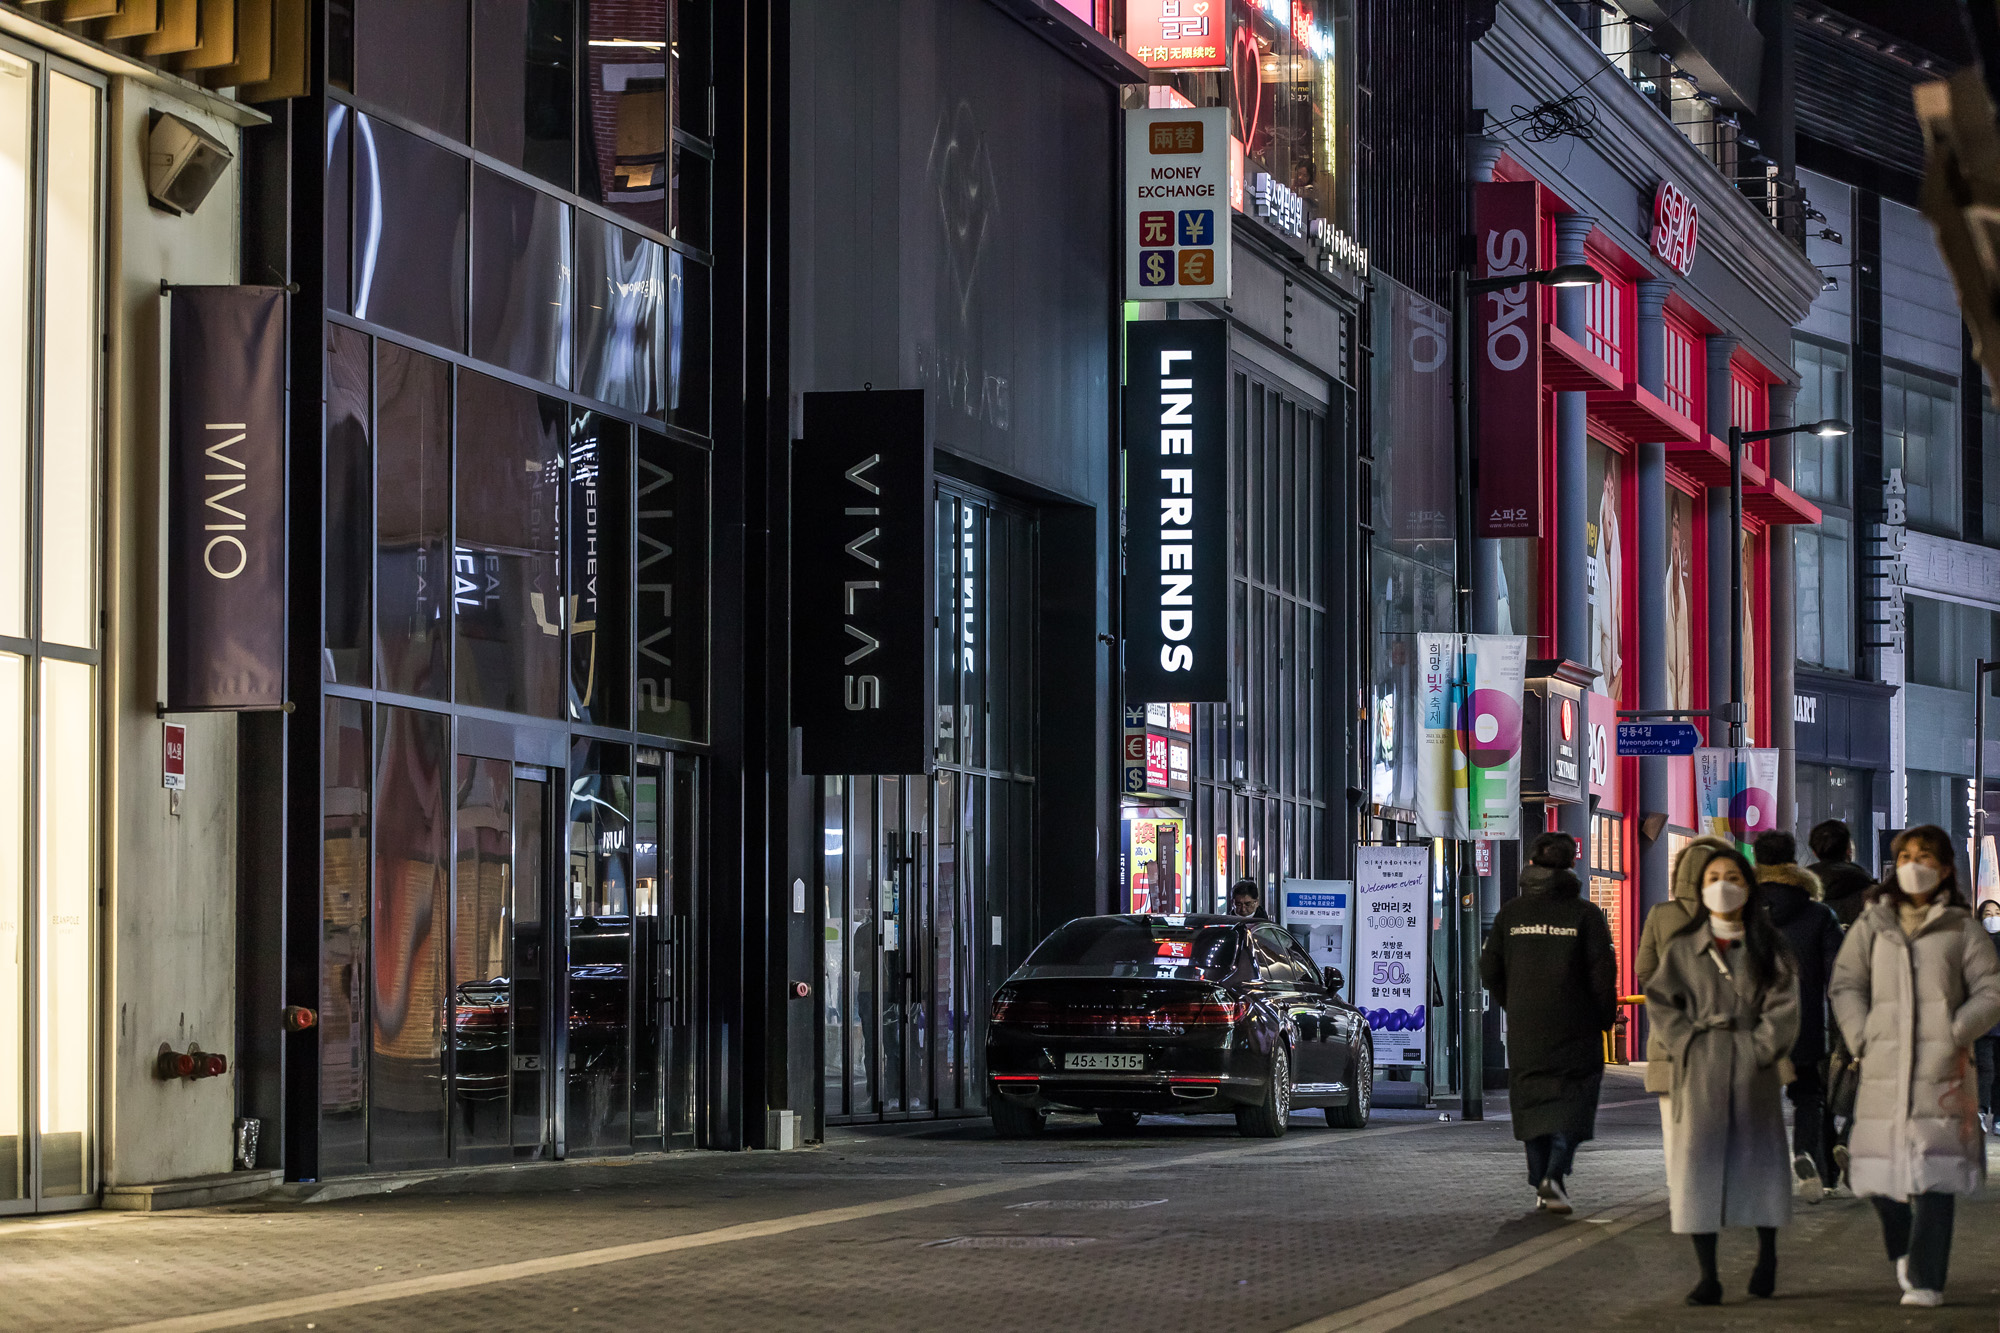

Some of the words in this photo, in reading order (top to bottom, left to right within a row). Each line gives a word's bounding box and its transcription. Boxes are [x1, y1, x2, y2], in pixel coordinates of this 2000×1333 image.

[1151, 166, 1202, 180] MONEY
[1138, 184, 1215, 198] EXCHANGE
[1144, 216, 1168, 242] 元
[1184, 213, 1204, 243] ¥
[1657, 181, 1698, 277] SPAO
[1146, 253, 1166, 285] $
[1183, 252, 1206, 282] €
[1486, 228, 1529, 372] SPAO
[1160, 350, 1193, 455] LINE
[1489, 508, 1528, 522] 스파오
[1160, 468, 1194, 673] FRIENDS
[1429, 643, 1441, 671] 희망
[1427, 673, 1443, 693] 빛
[1126, 706, 1144, 725] ¥
[1429, 697, 1441, 725] 축제
[1620, 726, 1652, 737] 명동4길
[1127, 737, 1144, 758] €
[1619, 739, 1663, 747] Myeongdong
[1664, 739, 1681, 747] 4-gil
[1128, 768, 1144, 790] $
[1360, 882, 1398, 894] Welcome
[1399, 873, 1424, 888] event
[1371, 902, 1400, 913] 앞머리
[1402, 902, 1412, 913] 컷
[1366, 915, 1405, 930] 1,000
[1406, 916, 1416, 928] 원
[1548, 924, 1578, 937] team
[1371, 950, 1412, 960] 컷/펌/염색
[1382, 941, 1404, 950] 첫방문
[1372, 961, 1412, 985] 50%
[1071, 1055, 1098, 1068] 45소
[1103, 1055, 1138, 1068] 1315
